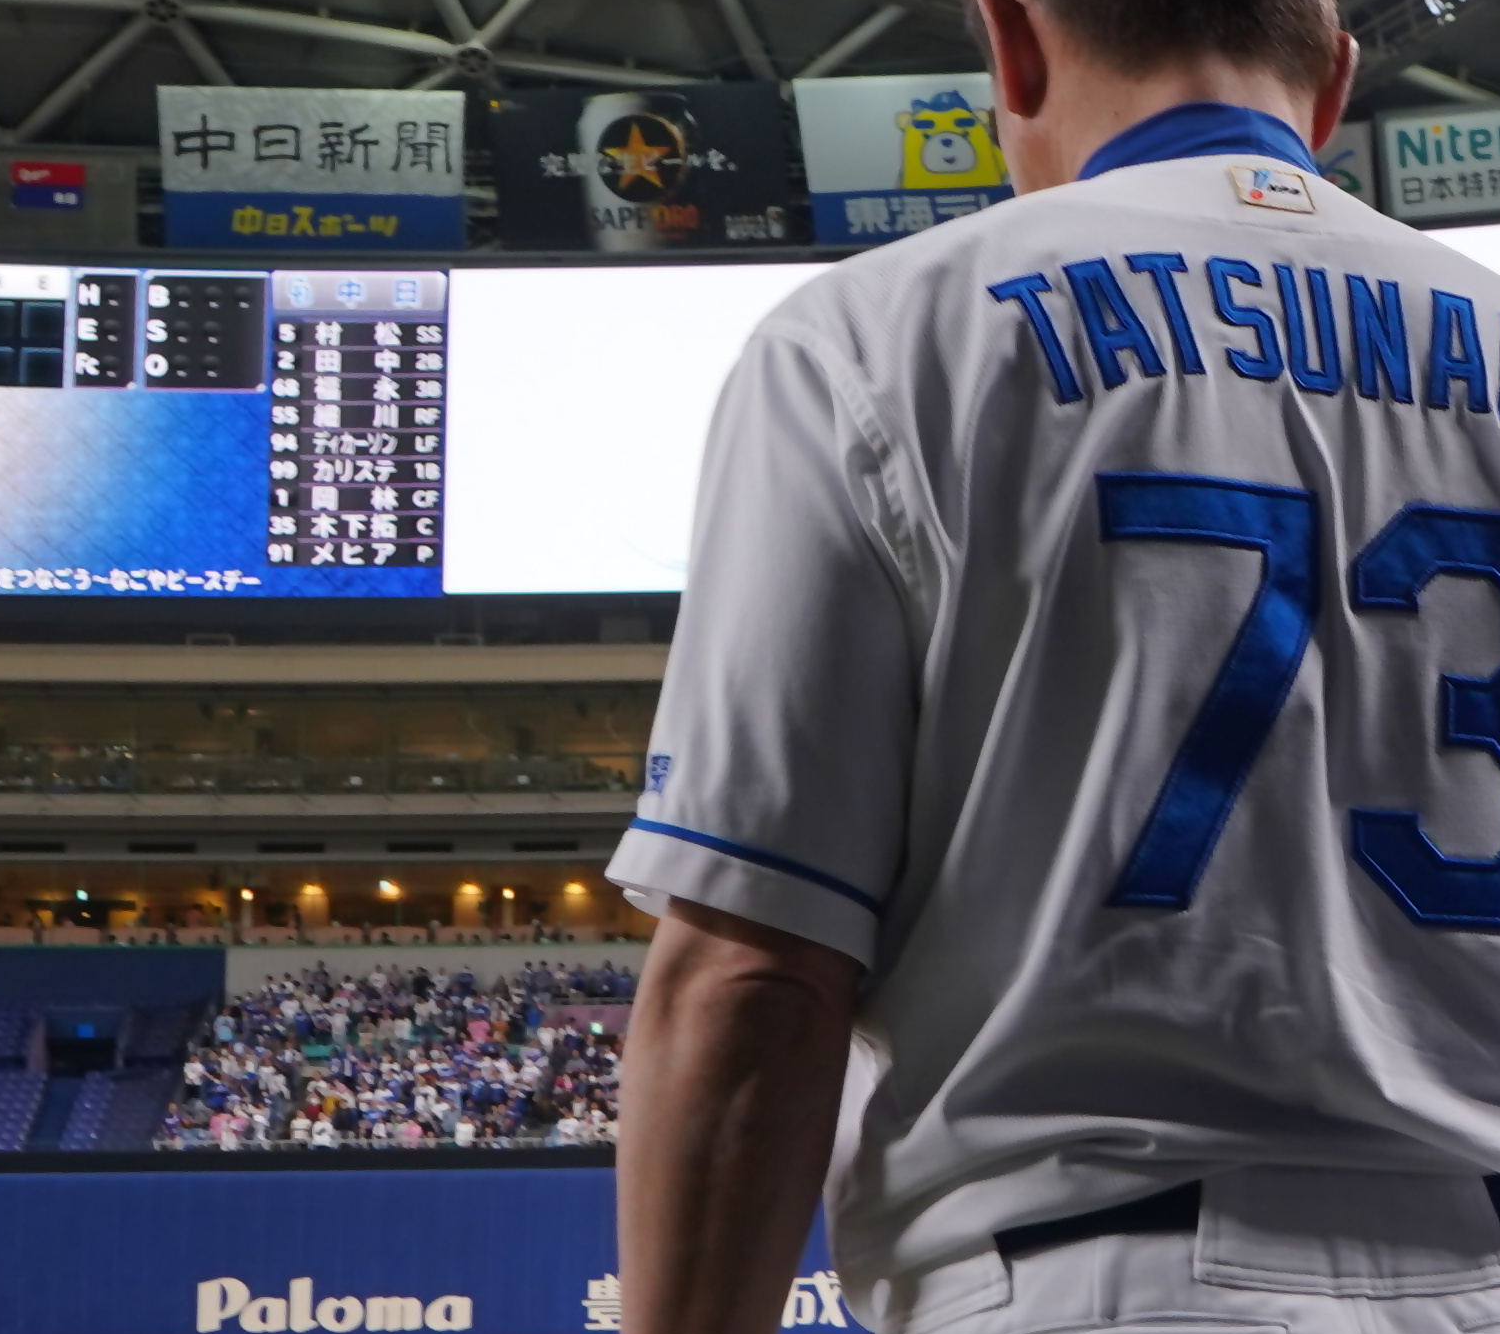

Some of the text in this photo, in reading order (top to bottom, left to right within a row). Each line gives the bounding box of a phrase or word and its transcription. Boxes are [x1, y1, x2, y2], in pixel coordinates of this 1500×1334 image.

[173, 114, 451, 174] 中日新聞
[232, 206, 398, 237] 中日スポーツ
[39, 276, 48, 289] E
[78, 284, 100, 305] H
[149, 286, 170, 307] B
[78, 319, 98, 341] E
[147, 320, 168, 342] S
[279, 321, 442, 347] 5 村松 SS
[145, 355, 168, 376] O
[278, 351, 295, 370] 2
[315, 350, 400, 375] 田中
[272, 406, 299, 425] 55
[313, 460, 397, 482] カリステ
[275, 489, 289, 507] 1
[269, 513, 434, 539] 35 木下拓 C
[311, 543, 396, 565] メヒア
[417, 545, 434, 563] P
[197, 1278, 473, 1333] Paloma
